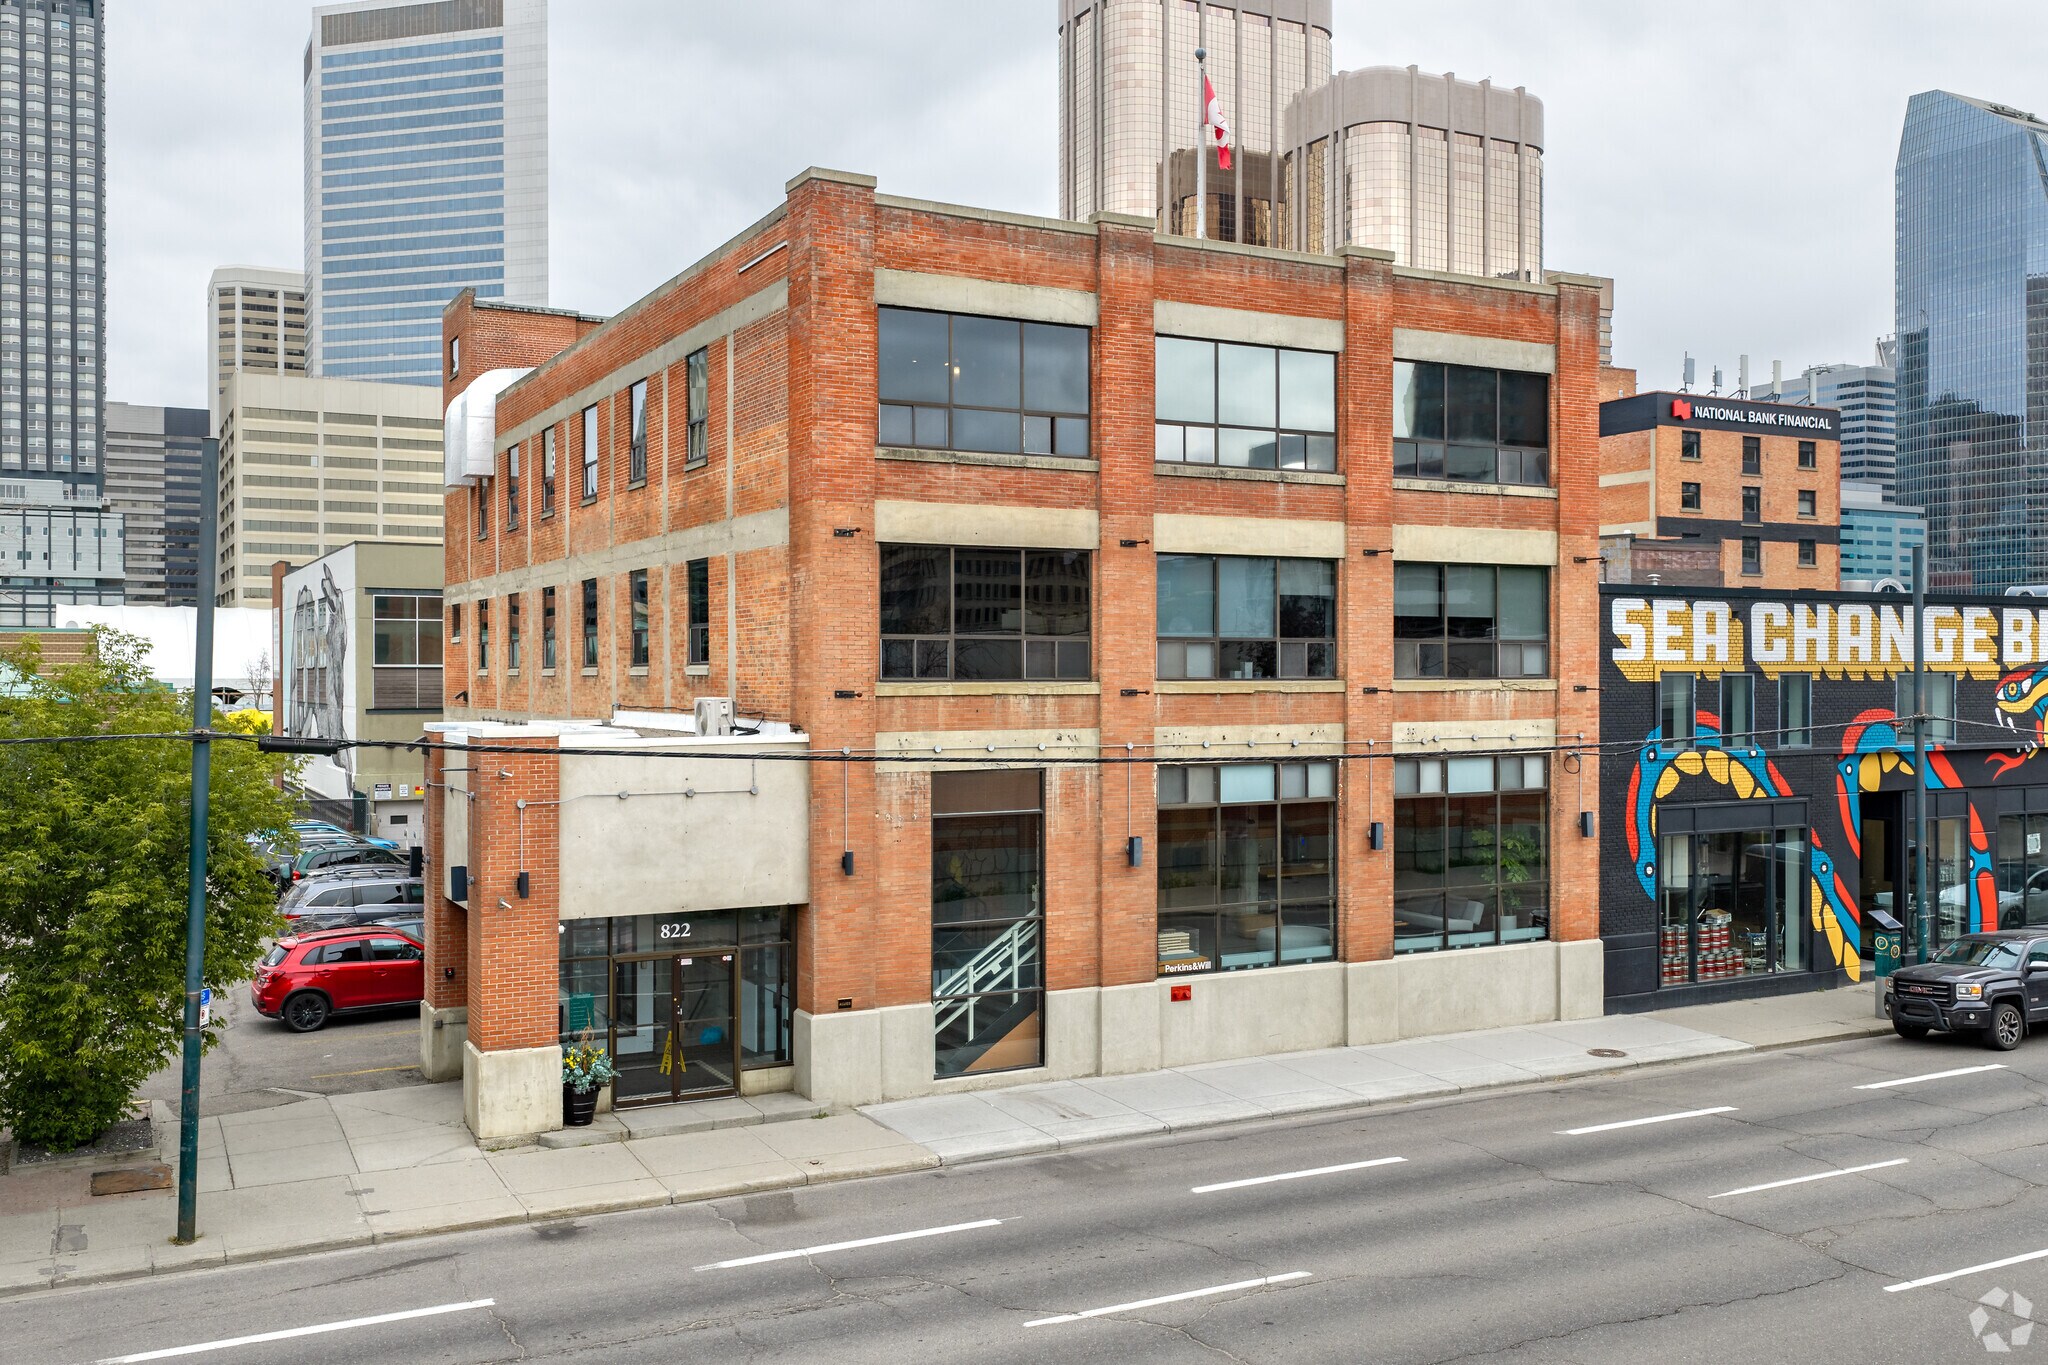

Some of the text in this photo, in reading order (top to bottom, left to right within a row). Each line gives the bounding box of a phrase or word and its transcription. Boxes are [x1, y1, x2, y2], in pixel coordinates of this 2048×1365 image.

[1694, 405, 1832, 430] NATIONAL BANK FINANCIAL
[1612, 597, 2048, 665] SEA CHANGE B
[660, 922, 691, 939] 822
[1164, 960, 1212, 973] Perkins&Will
[1909, 985, 1933, 994] GMC
